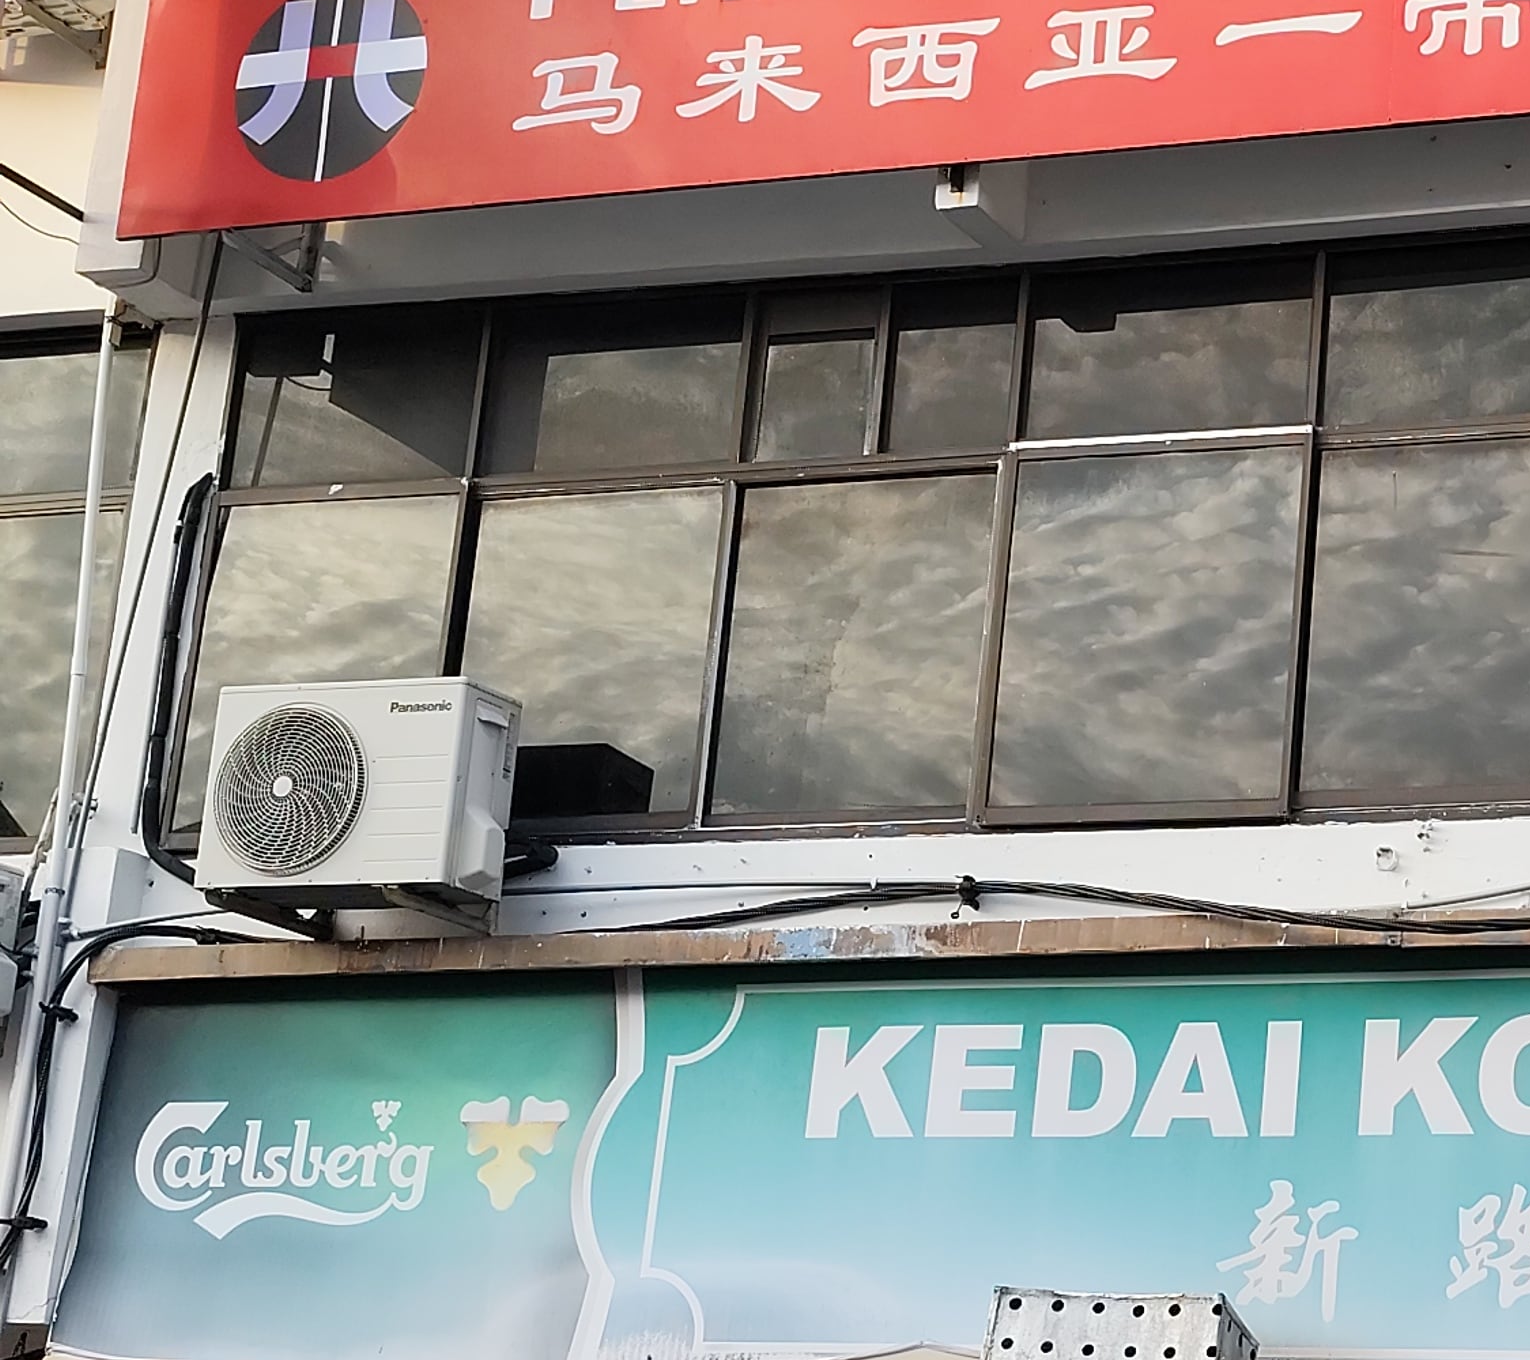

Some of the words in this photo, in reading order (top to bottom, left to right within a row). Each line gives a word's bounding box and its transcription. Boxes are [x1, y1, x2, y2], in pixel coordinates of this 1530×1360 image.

[390, 699, 453, 713] Panasonic
[804, 1019, 1304, 1139] KEDAI
[135, 1100, 434, 1214] Carlsberg
